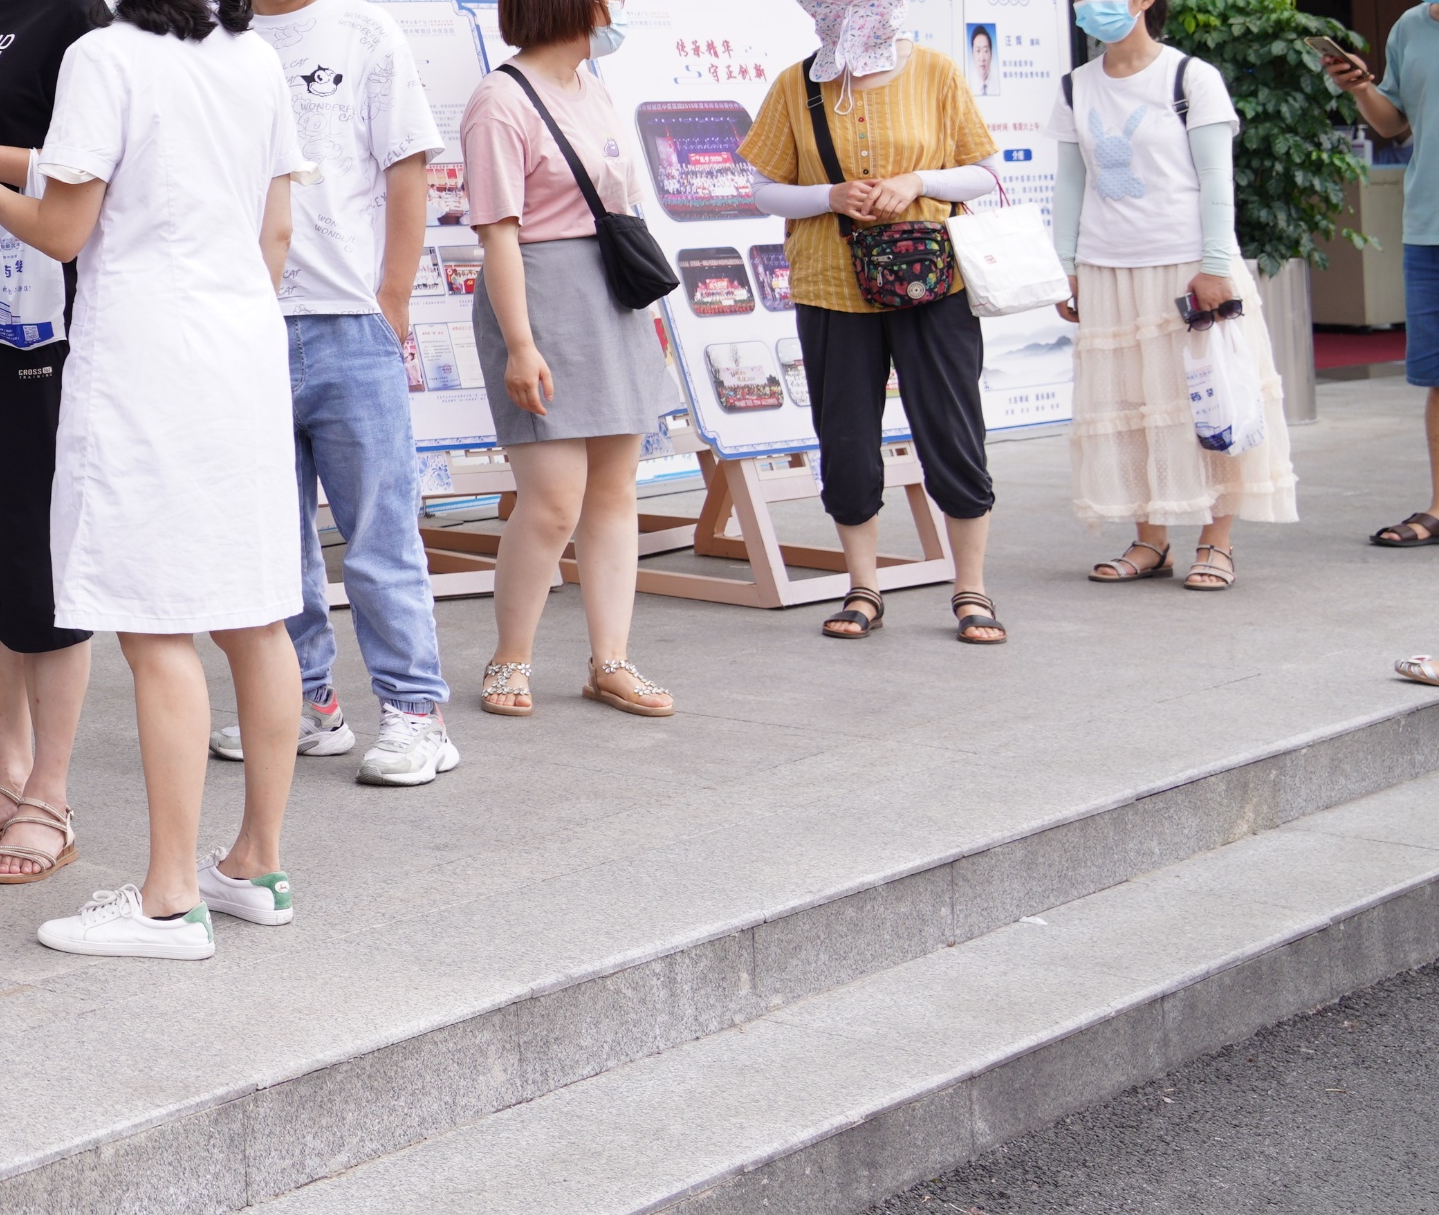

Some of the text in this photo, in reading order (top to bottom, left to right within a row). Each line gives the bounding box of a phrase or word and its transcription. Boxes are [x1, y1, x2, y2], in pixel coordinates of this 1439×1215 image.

[708, 63, 767, 83] 守正创新
[282, 268, 302, 279] CAT
[18, 368, 43, 376] CROSS
